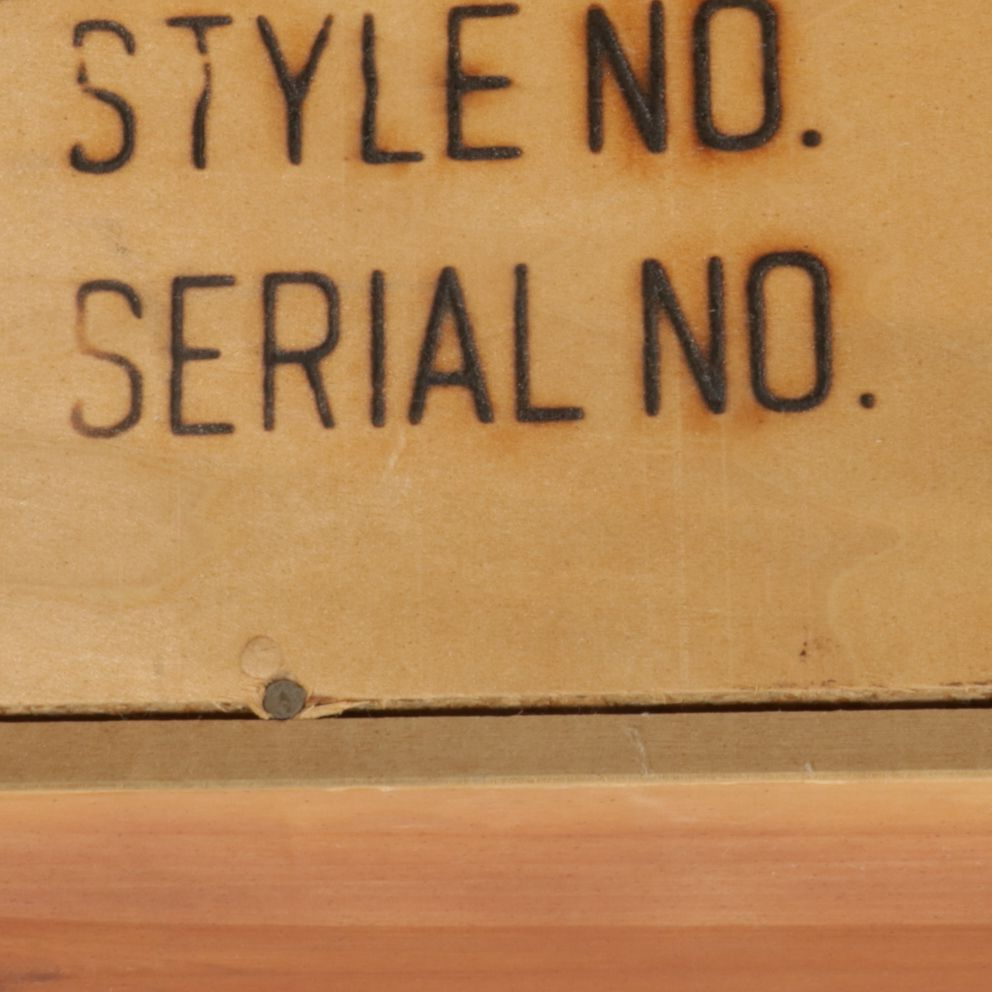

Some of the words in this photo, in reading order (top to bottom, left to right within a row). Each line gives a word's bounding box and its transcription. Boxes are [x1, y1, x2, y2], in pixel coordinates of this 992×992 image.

[69, 3, 523, 174] STYLE
[71, 262, 585, 438] SERIAL
[642, 250, 877, 416] NO.
